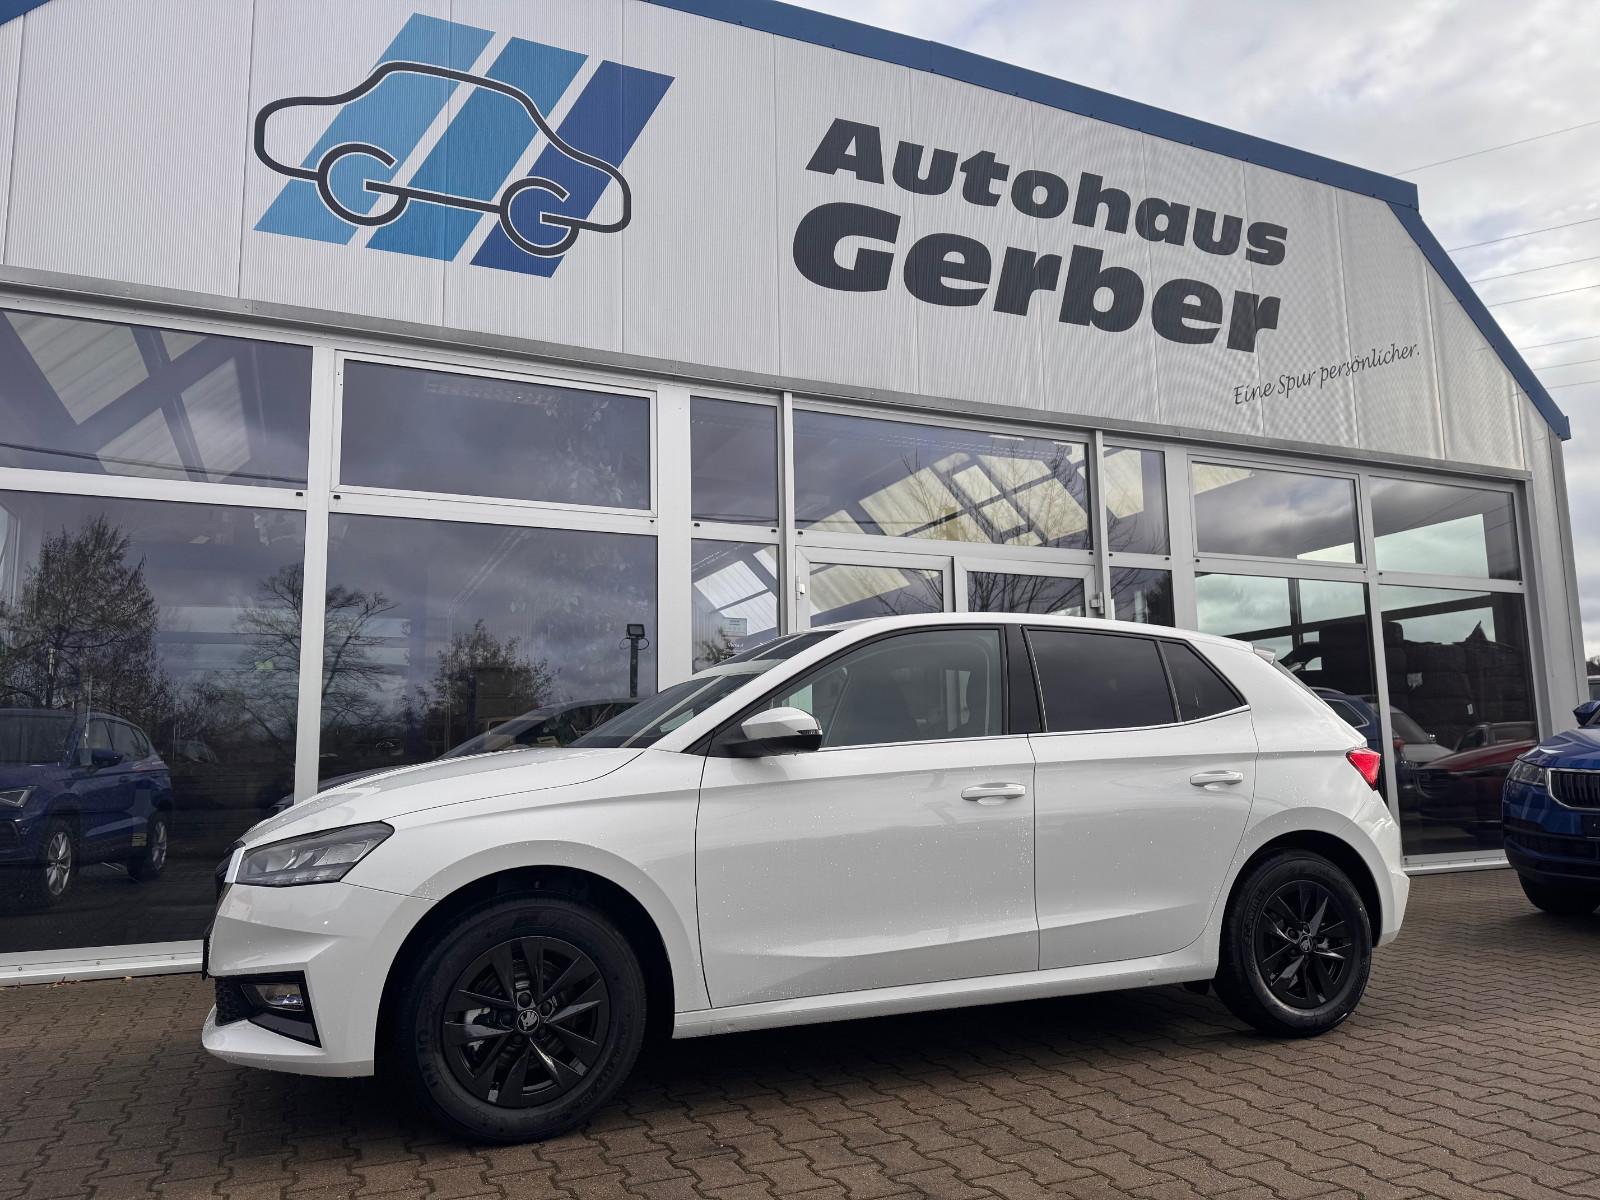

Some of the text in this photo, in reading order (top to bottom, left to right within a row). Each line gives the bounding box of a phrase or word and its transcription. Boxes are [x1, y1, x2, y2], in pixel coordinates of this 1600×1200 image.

[806, 118, 1287, 265] Autohaus
[792, 202, 1280, 352] Gerber
[1233, 343, 1420, 405] Eine Spur persönlicher.
